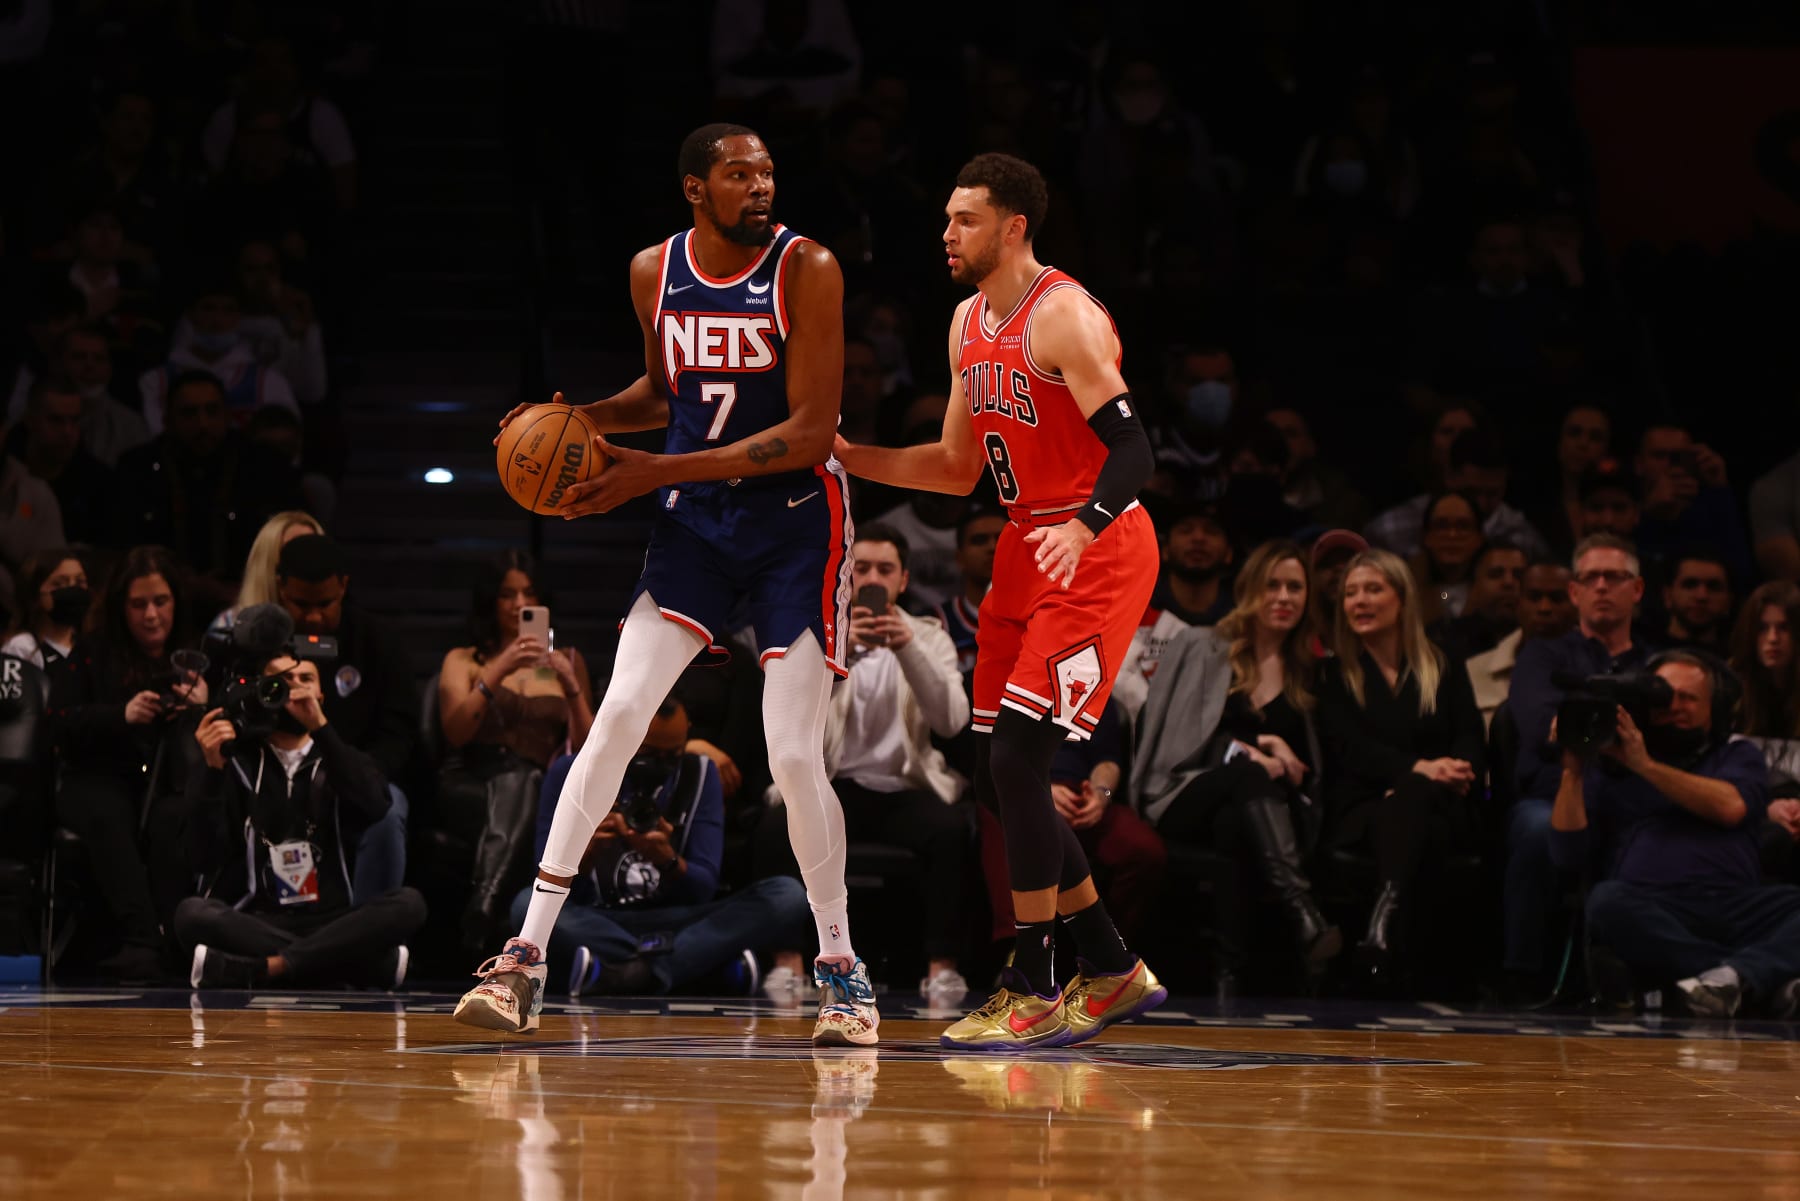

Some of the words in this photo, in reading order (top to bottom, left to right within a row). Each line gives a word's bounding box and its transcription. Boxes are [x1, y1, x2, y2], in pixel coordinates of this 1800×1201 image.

[745, 297, 768, 305] Webull
[661, 311, 779, 394] NETS
[700, 382, 738, 442] 7
[543, 443, 584, 508] Wilson
[984, 432, 1020, 503] 8
[0, 682, 22, 700] YS
